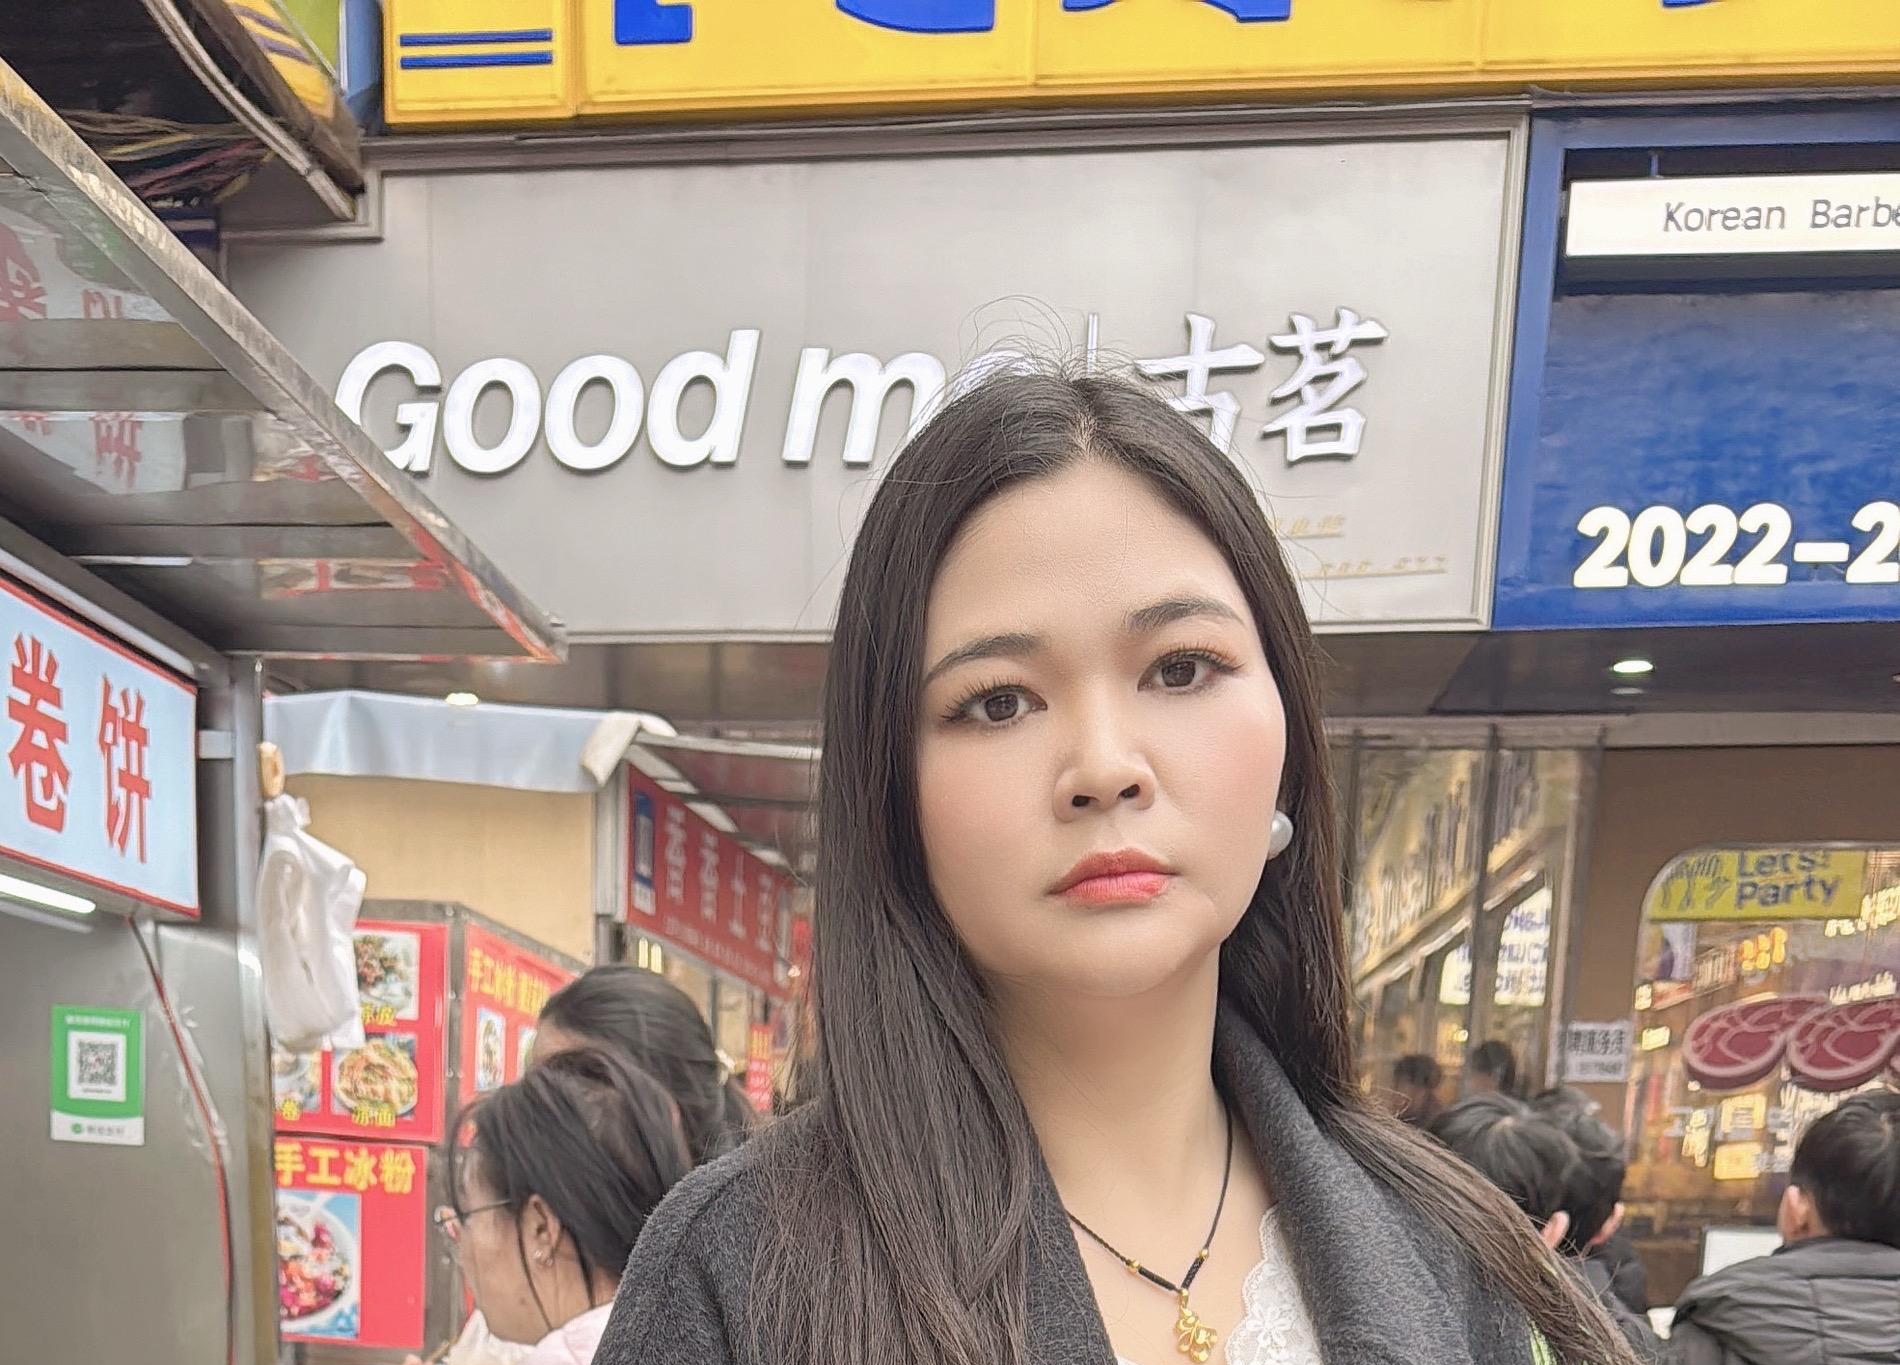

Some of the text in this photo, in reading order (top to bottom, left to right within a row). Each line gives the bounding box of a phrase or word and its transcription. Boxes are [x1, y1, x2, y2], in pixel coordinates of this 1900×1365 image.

[1663, 201, 1785, 232] Korean
[336, 329, 1042, 475] Good m
[1133, 306, 1389, 465] 古茗
[7, 632, 152, 864] 卷饼
[1735, 874, 1840, 911] Party
[274, 1142, 416, 1194] 手工冰粉
